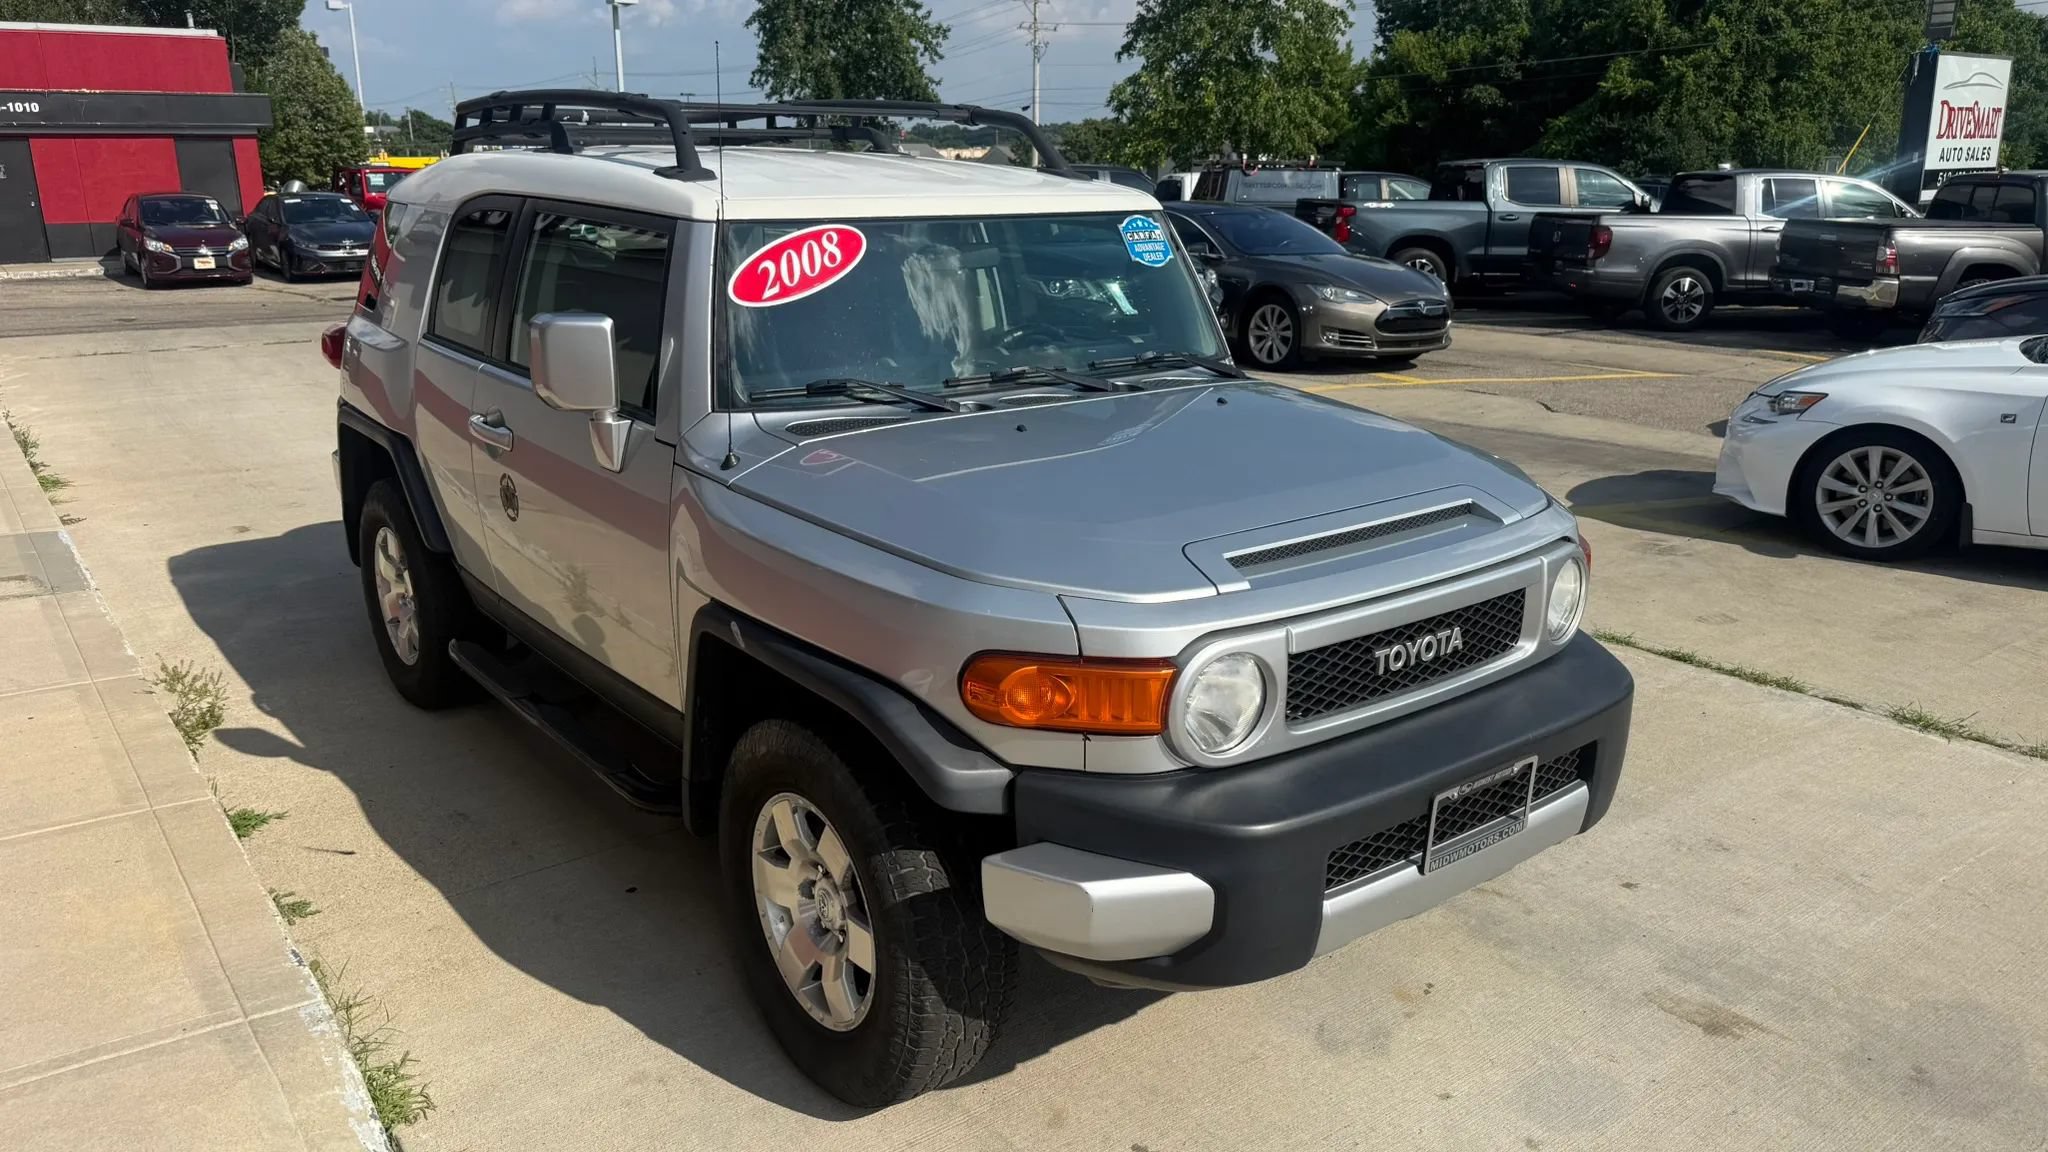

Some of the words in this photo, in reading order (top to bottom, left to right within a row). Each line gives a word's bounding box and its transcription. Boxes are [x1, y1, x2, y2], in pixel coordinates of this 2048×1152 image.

[0, 102, 40, 113] -1010
[1939, 147, 1963, 162] AUTO
[1964, 146, 1992, 161] SALES
[1126, 230, 1163, 242] CARFAX
[1134, 241, 1166, 252] ADVANTAGE
[1143, 252, 1165, 261] DEALER
[757, 231, 842, 300] 2008
[1375, 627, 1463, 675] TOYOTA
[1429, 821, 1525, 872] MIDWMOTORS.COM
